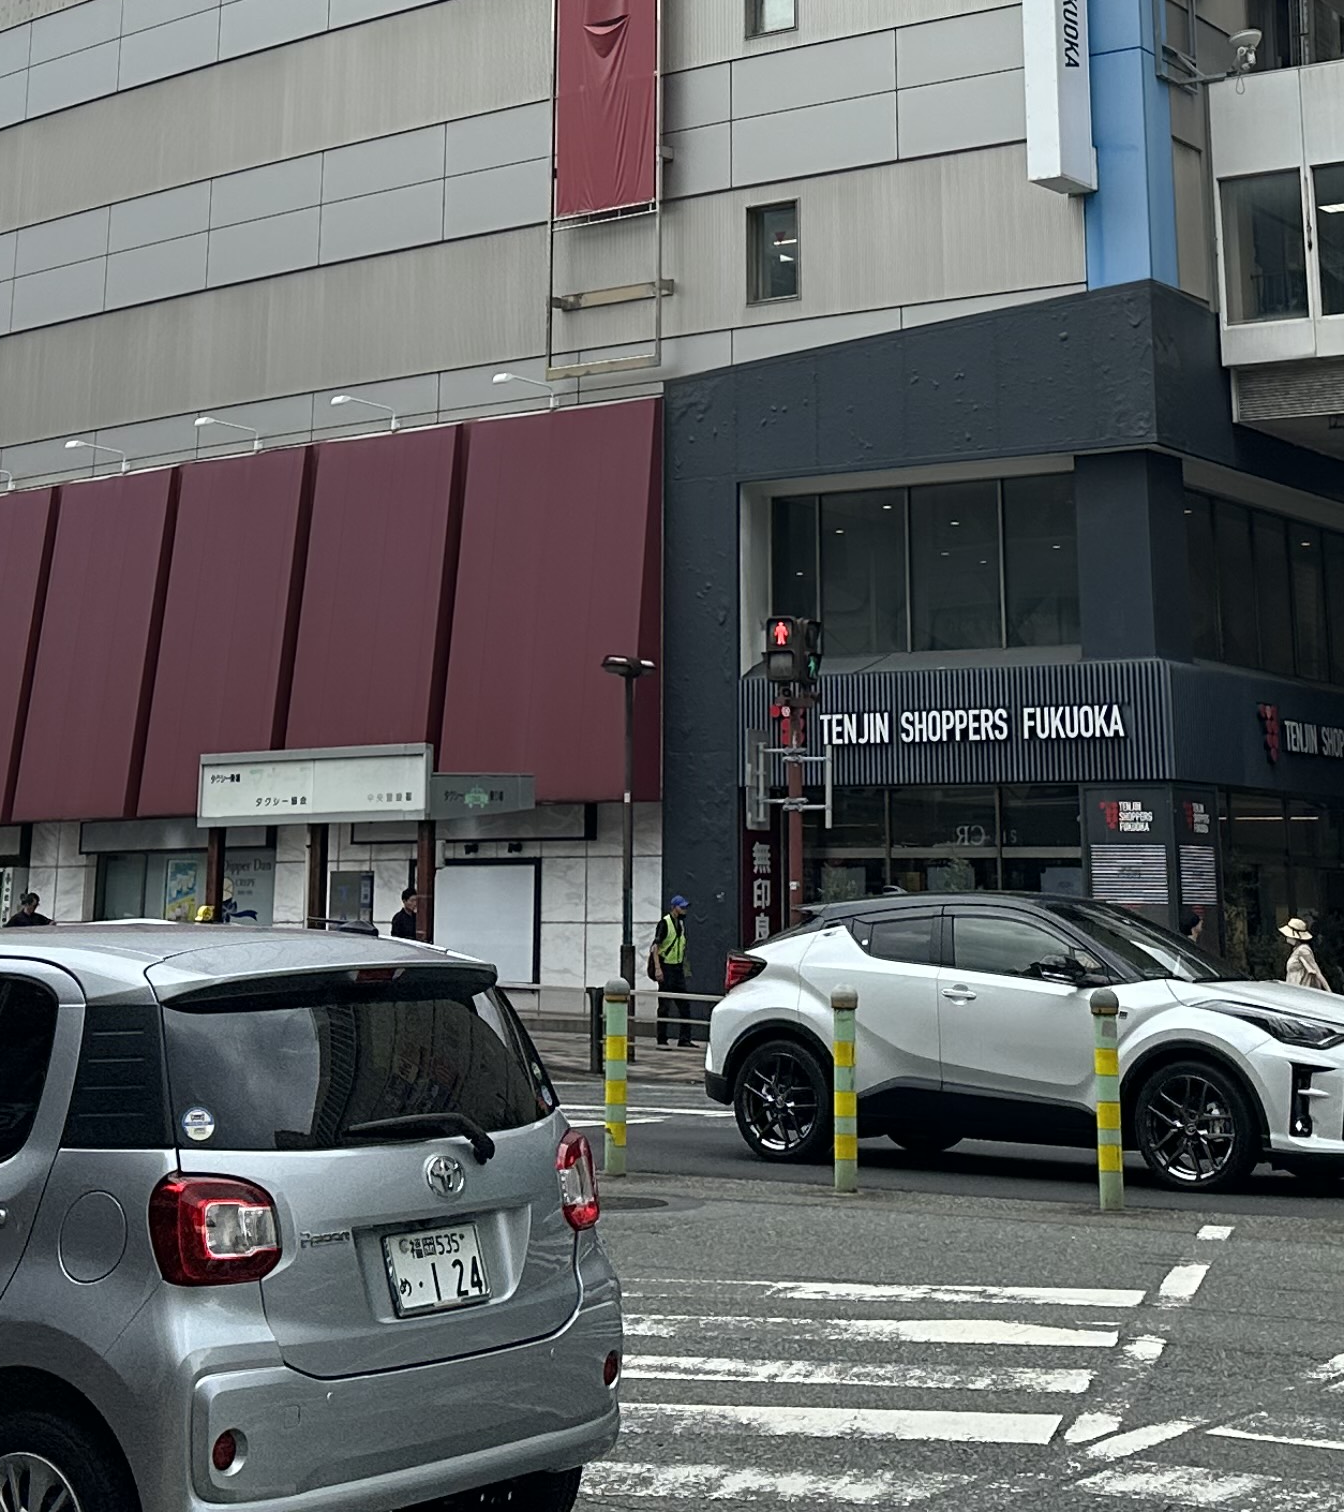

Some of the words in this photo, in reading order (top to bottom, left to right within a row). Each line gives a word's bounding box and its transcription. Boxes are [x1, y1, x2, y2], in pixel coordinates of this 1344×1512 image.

[820, 712, 890, 745] TENJIN
[901, 708, 1009, 743] SHOPPERS
[1023, 704, 1125, 739] FUKUOKA
[1284, 720, 1318, 754] TENJIN
[752, 841, 772, 945] 無印良
